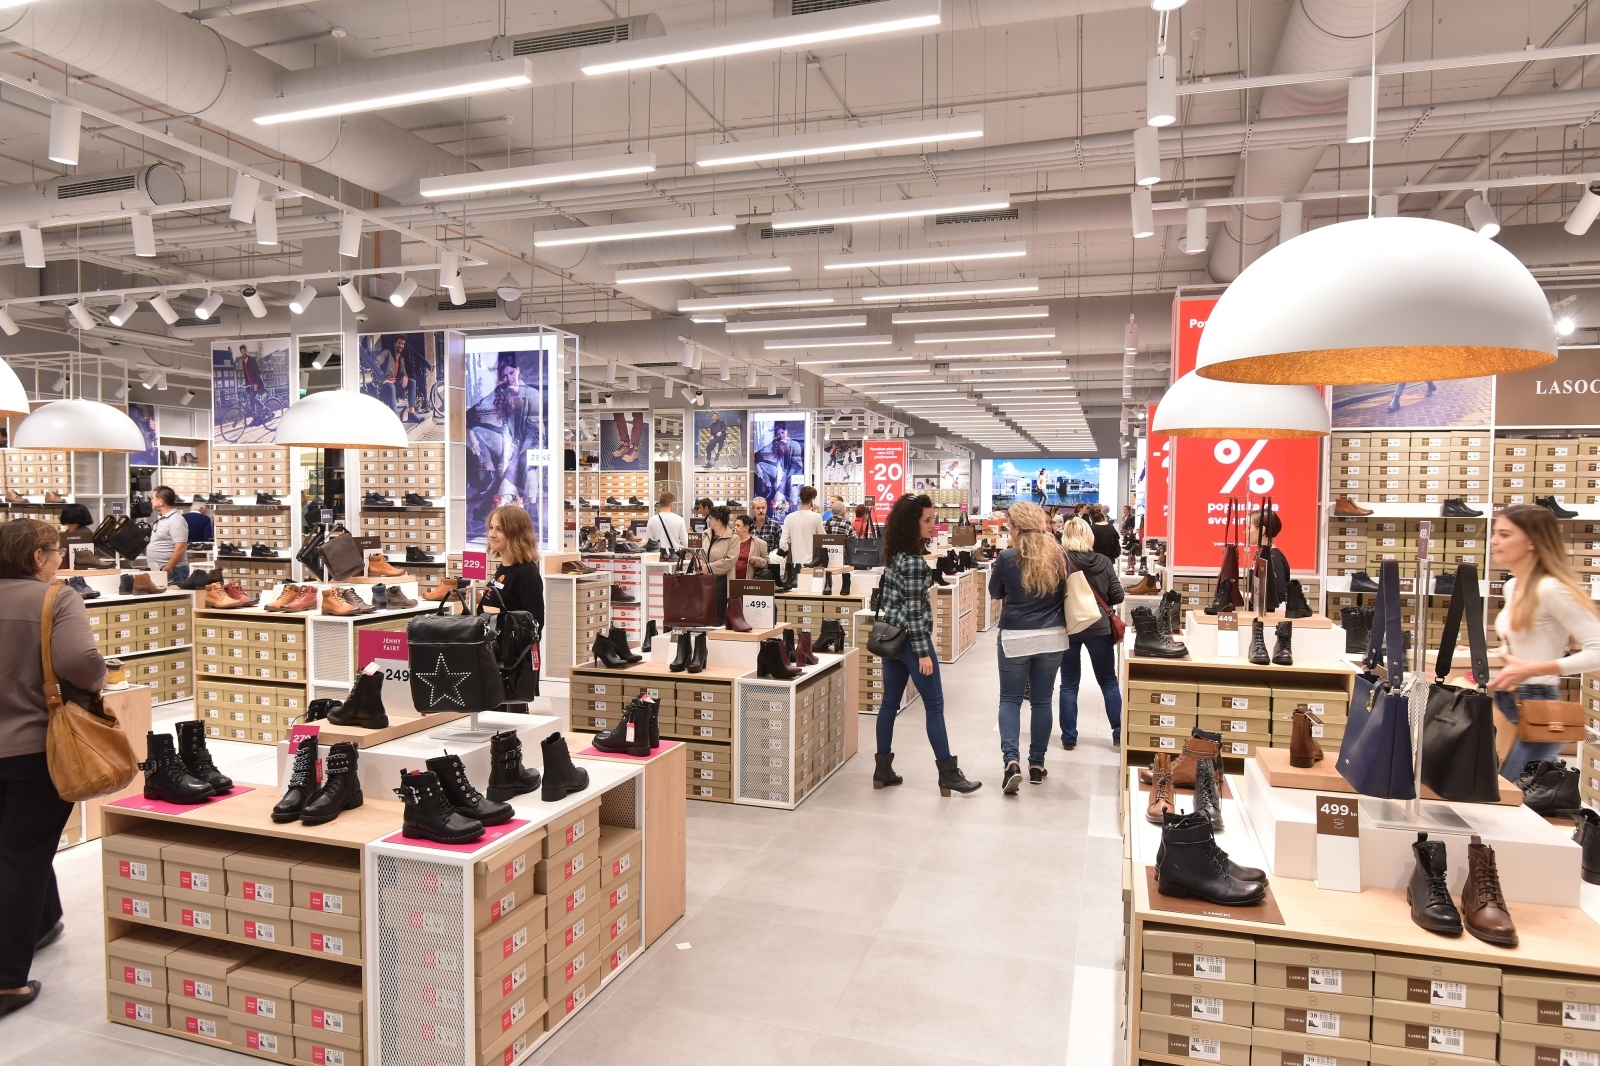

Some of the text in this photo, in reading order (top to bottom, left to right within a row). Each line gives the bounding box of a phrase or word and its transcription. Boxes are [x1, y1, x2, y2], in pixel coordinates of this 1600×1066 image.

[1535, 379, 1600, 394] LASOC
[869, 463, 902, 480] -20
[1214, 438, 1274, 494] %
[877, 484, 894, 501] %
[1208, 517, 1227, 525] sve
[464, 560, 480, 569] 229
[386, 669, 409, 682] 249
[1321, 803, 1349, 816] 499
